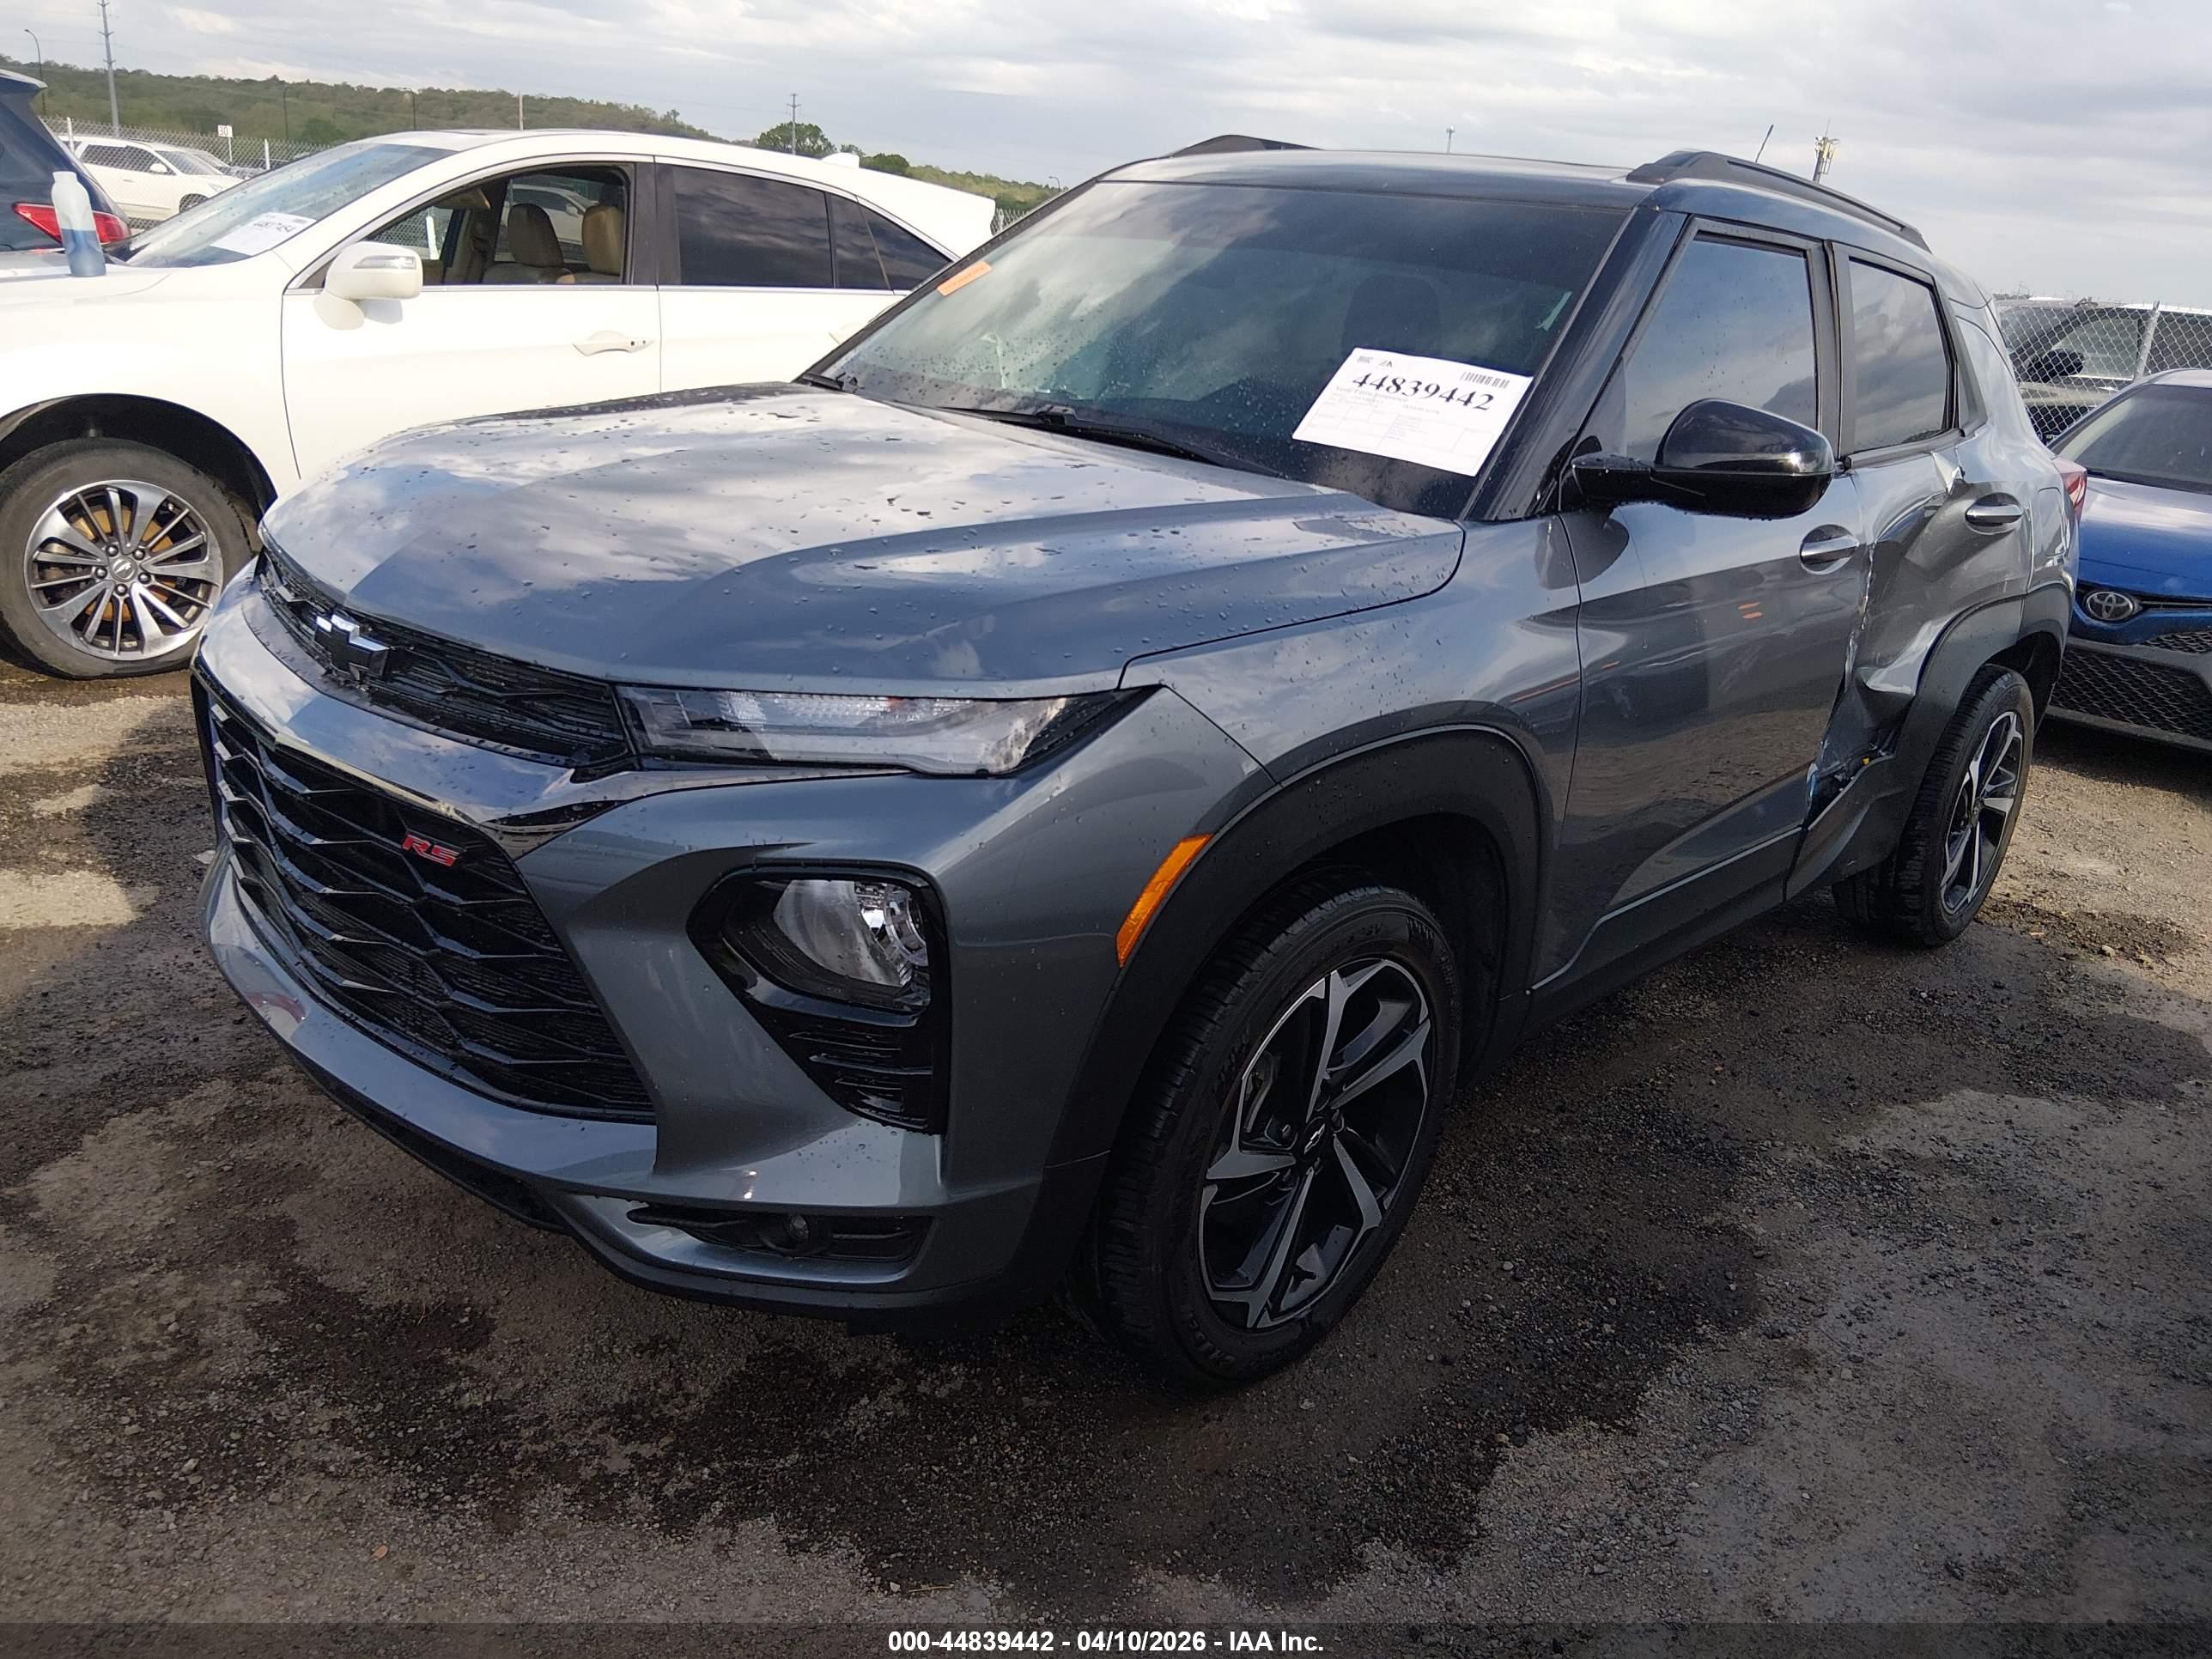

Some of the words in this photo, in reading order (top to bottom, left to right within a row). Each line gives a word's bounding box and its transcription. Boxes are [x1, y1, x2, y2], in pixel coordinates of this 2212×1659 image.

[219, 125, 228, 137] 30
[1352, 372, 1494, 411] 44839442
[402, 834, 460, 867] RS
